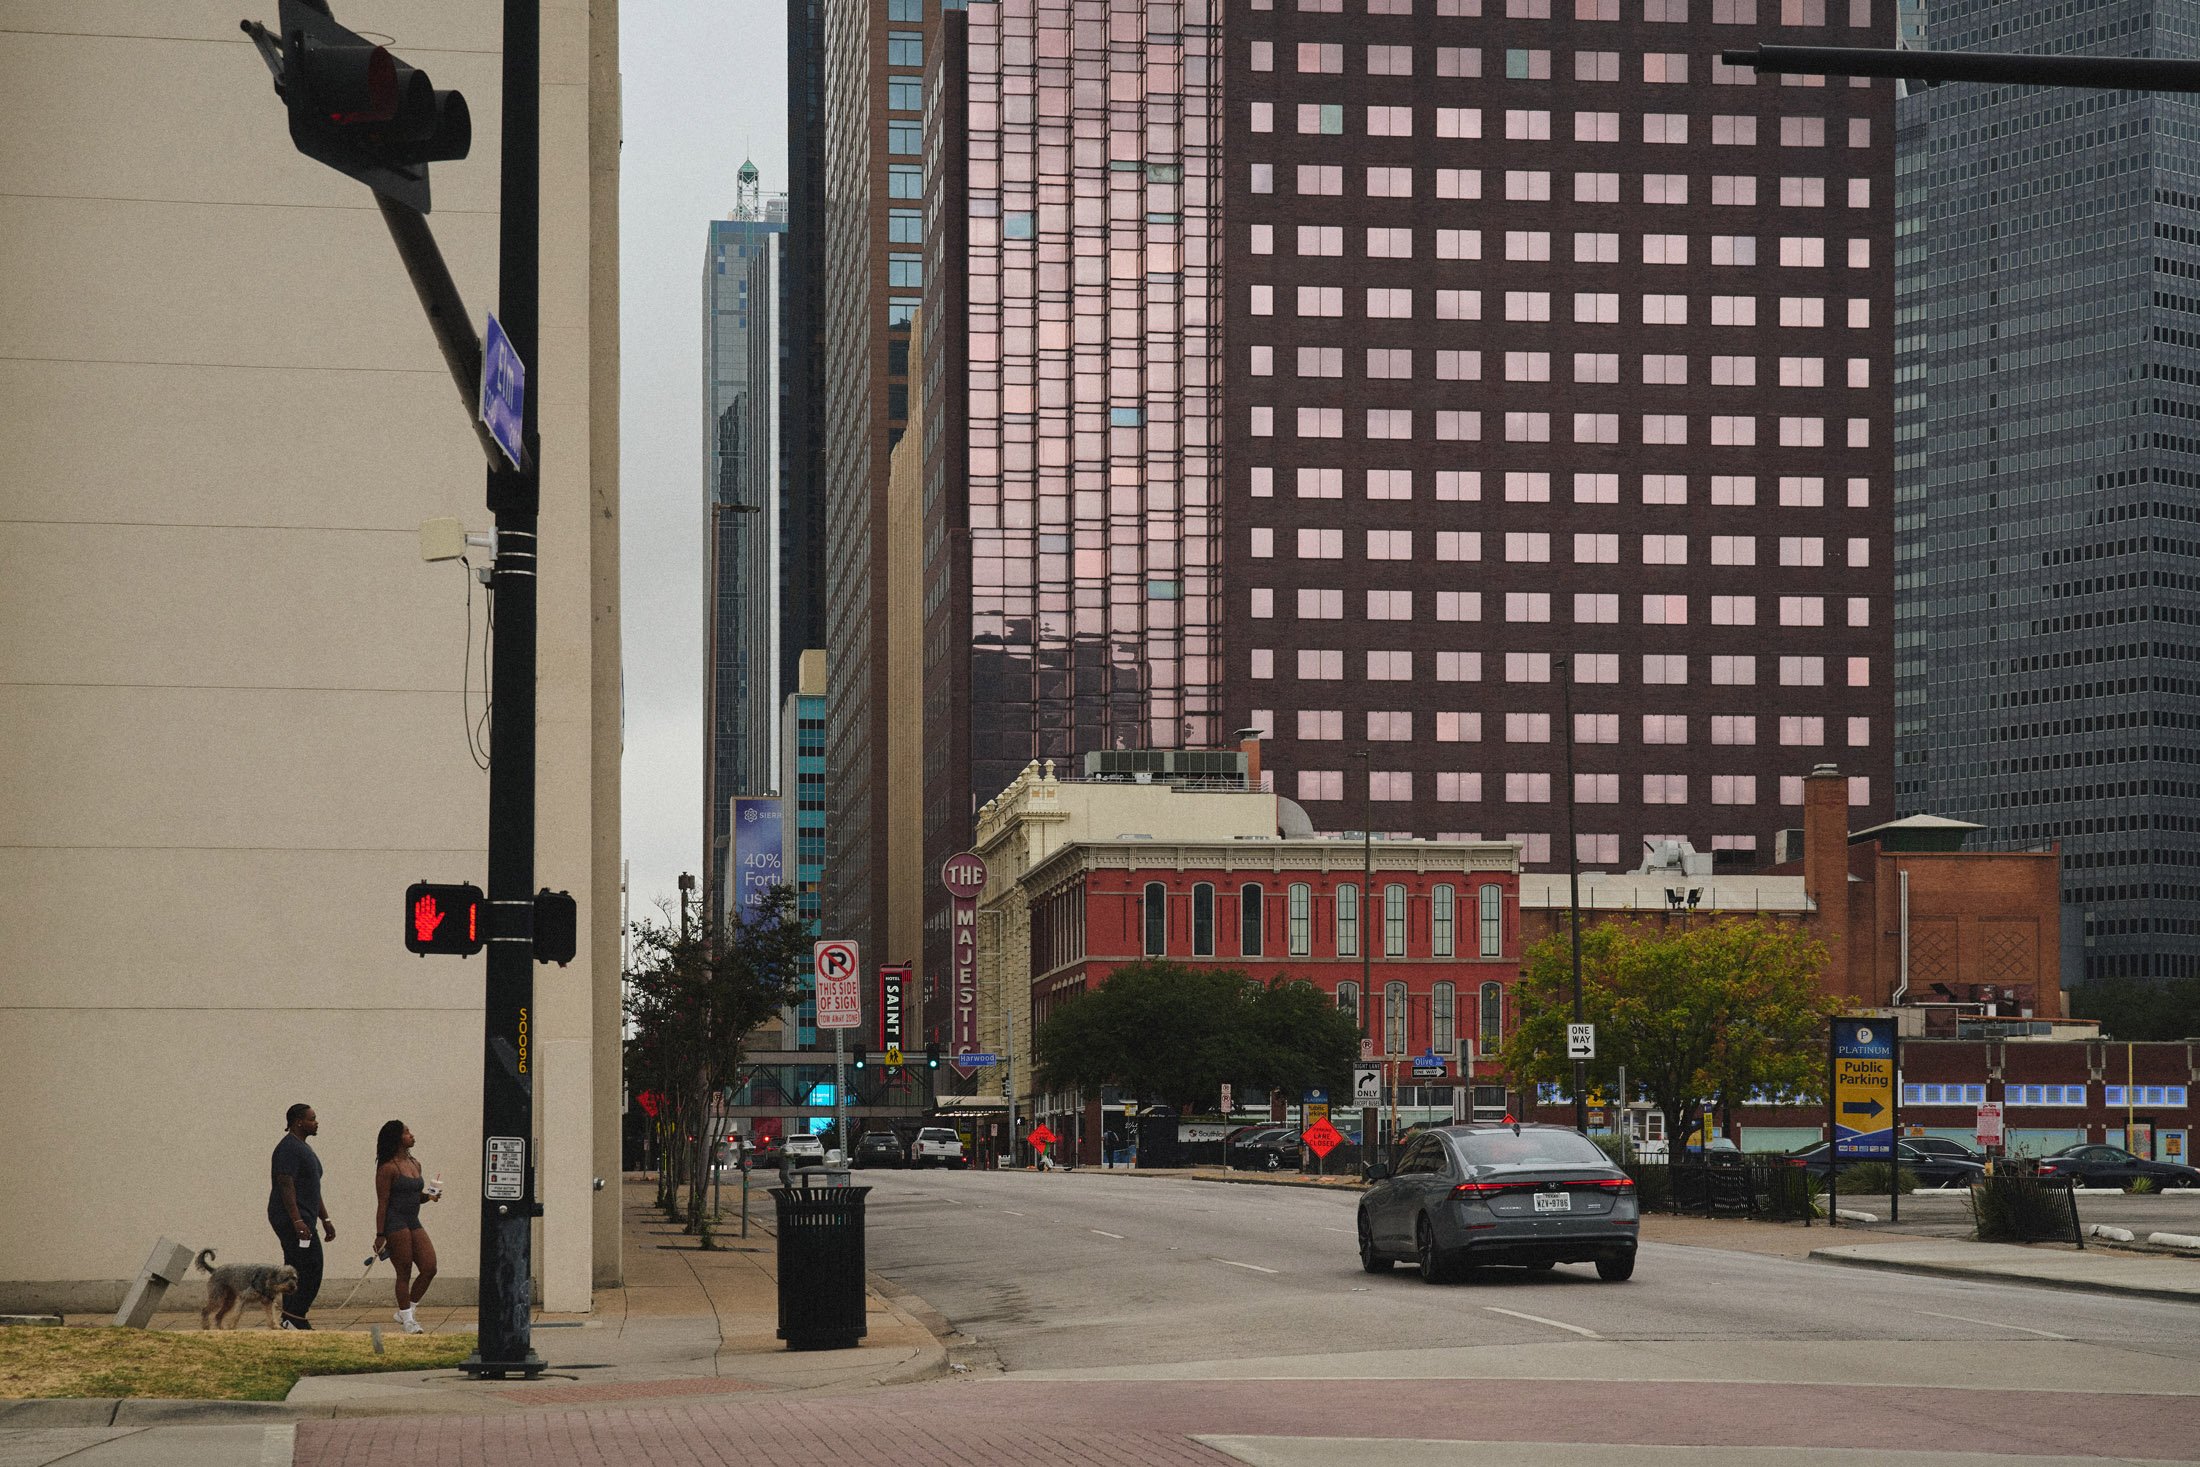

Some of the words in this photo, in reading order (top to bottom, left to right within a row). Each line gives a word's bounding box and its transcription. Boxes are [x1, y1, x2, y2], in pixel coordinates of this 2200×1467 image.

[497, 341, 514, 410] Elm
[744, 853, 781, 868] 40%
[745, 871, 781, 886] Fort
[948, 865, 983, 886] THE
[818, 982, 837, 996] THIS
[839, 981, 857, 995] SIDE
[820, 996, 832, 1010] OF
[835, 996, 857, 1009] SIGN
[886, 985, 900, 1035] SAINT
[820, 1015, 831, 1023] TOW
[832, 1014, 845, 1022] AWAY
[846, 1013, 858, 1022] ZONE
[1573, 1026, 1589, 1034] ONE
[1573, 1035, 1590, 1043] WAY
[1838, 1046, 1890, 1055] PLATINUM
[960, 1054, 995, 1062] Harwood
[1415, 1057, 1433, 1066] Olive
[1844, 1061, 1884, 1073] Public
[1839, 1074, 1889, 1088] Parking
